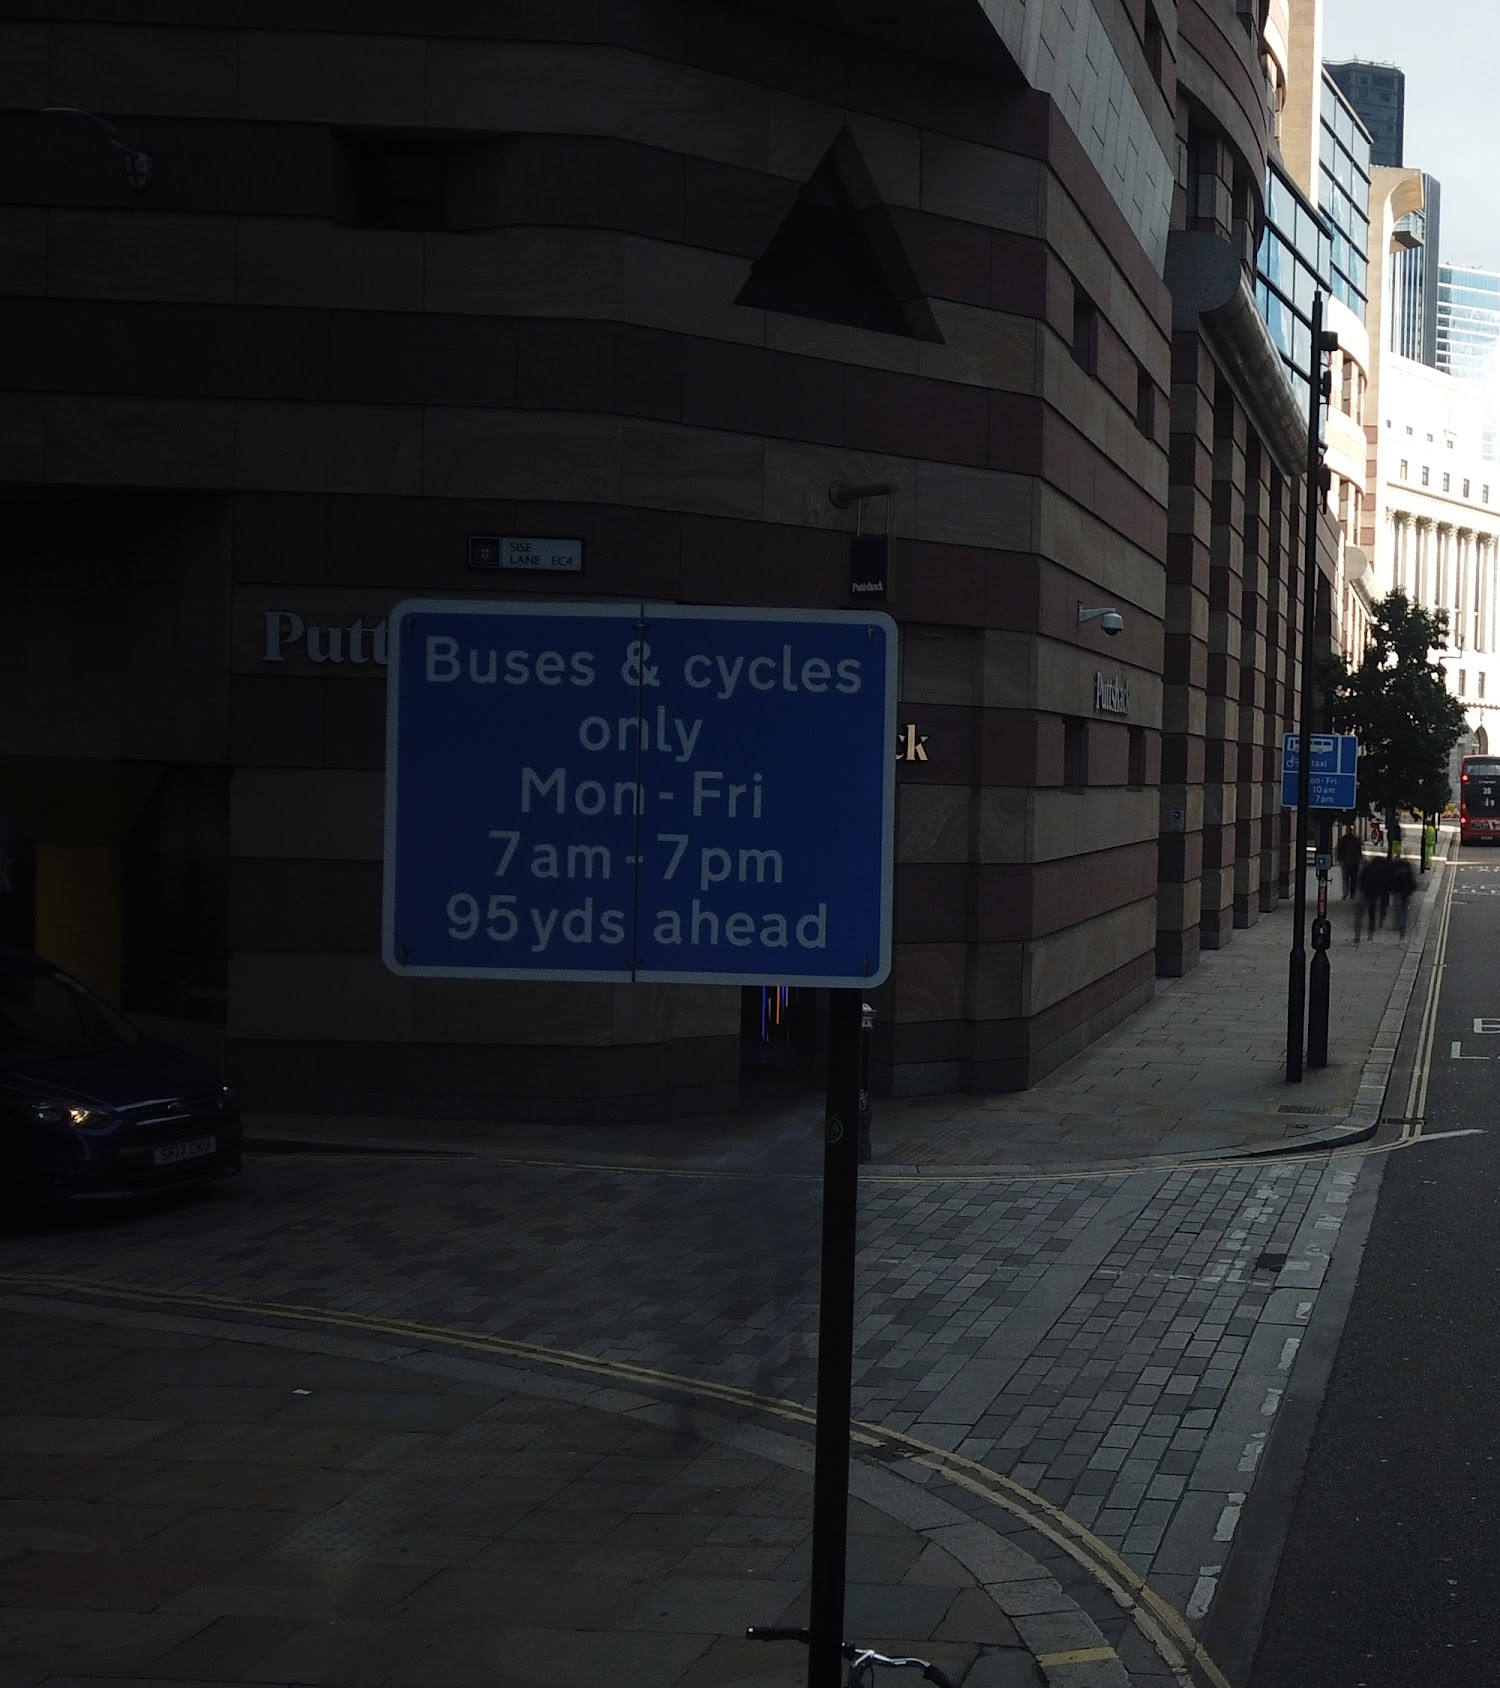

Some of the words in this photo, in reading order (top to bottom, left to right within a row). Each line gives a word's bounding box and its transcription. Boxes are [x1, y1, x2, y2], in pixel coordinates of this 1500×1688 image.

[510, 541, 532, 552] SISE
[510, 555, 541, 565] LANE
[551, 556, 573, 566] EC4
[425, 635, 596, 687] Buses
[621, 640, 661, 687] &
[683, 644, 863, 700] cycles
[579, 705, 703, 762] only
[446, 893, 626, 952] 95yds
[652, 897, 828, 949] ahead
